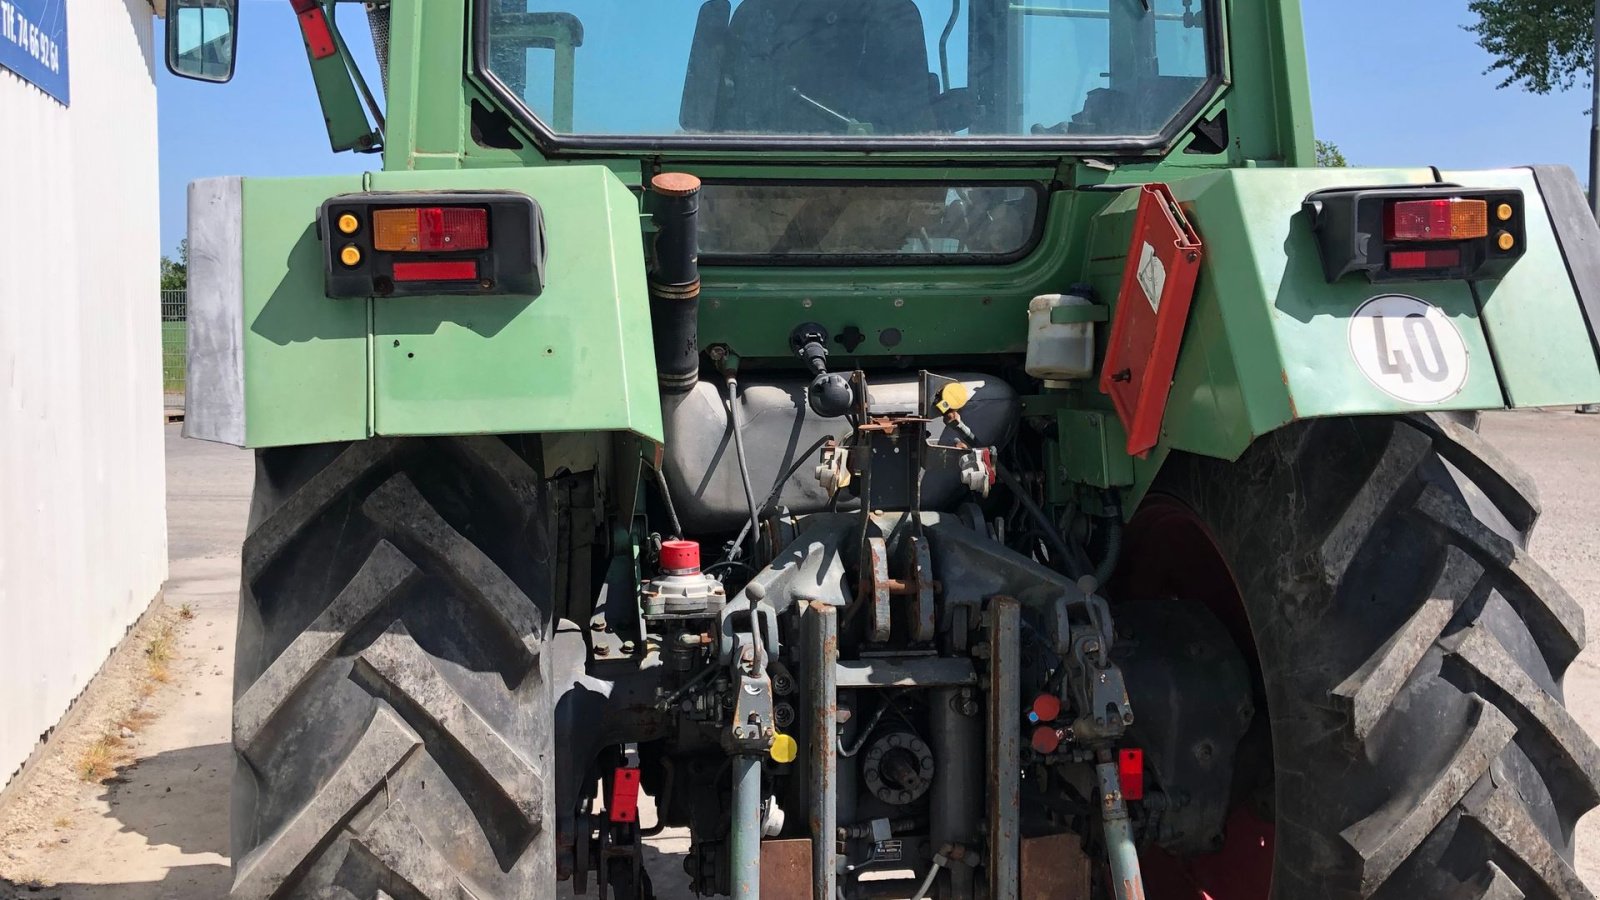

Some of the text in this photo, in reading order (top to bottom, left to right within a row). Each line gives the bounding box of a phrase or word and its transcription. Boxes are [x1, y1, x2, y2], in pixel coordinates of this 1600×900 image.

[1, 0, 59, 75] Tlf. 74 66 92 64
[1373, 313, 1449, 383] 40
